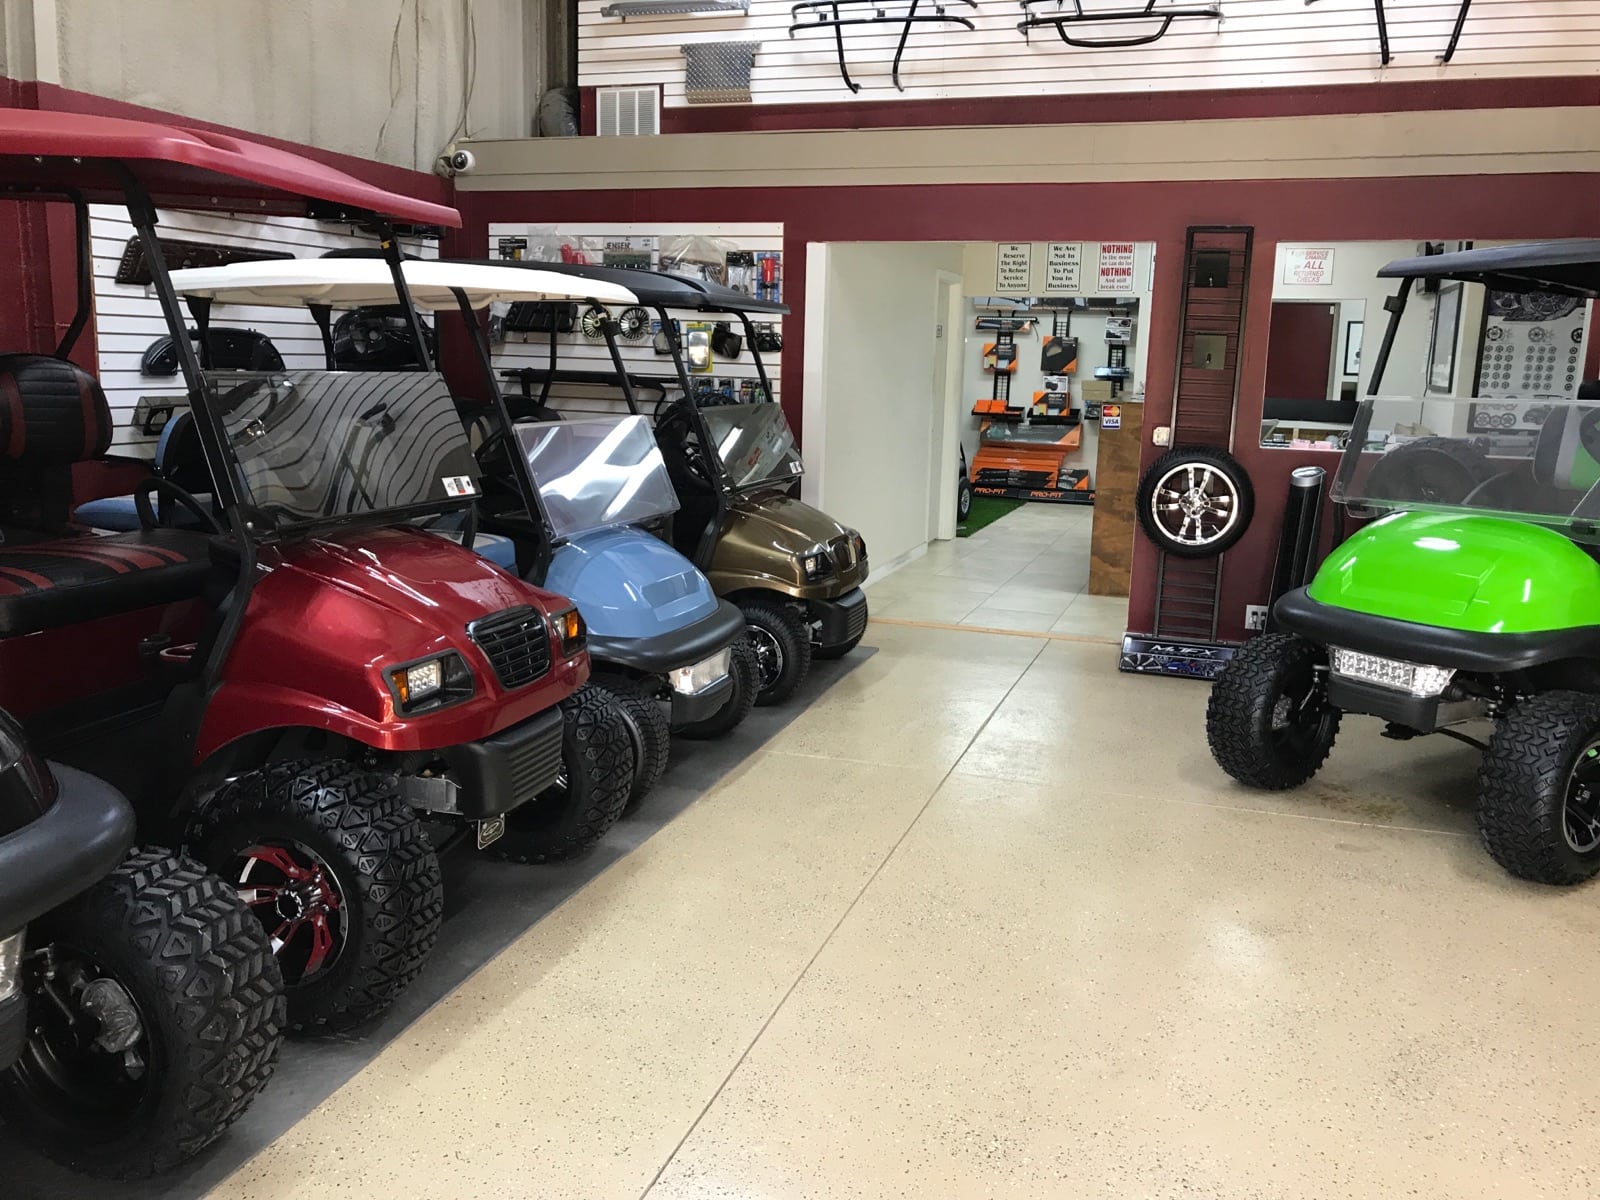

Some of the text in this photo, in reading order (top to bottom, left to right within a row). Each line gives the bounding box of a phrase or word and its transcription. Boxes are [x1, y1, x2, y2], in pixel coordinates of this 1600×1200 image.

[605, 241, 631, 249] JENSEN
[1101, 244, 1133, 254] NOTHING
[1303, 260, 1325, 270] ALL
[1100, 267, 1132, 277] NOTHING
[974, 487, 1007, 495] PRO-FIT
